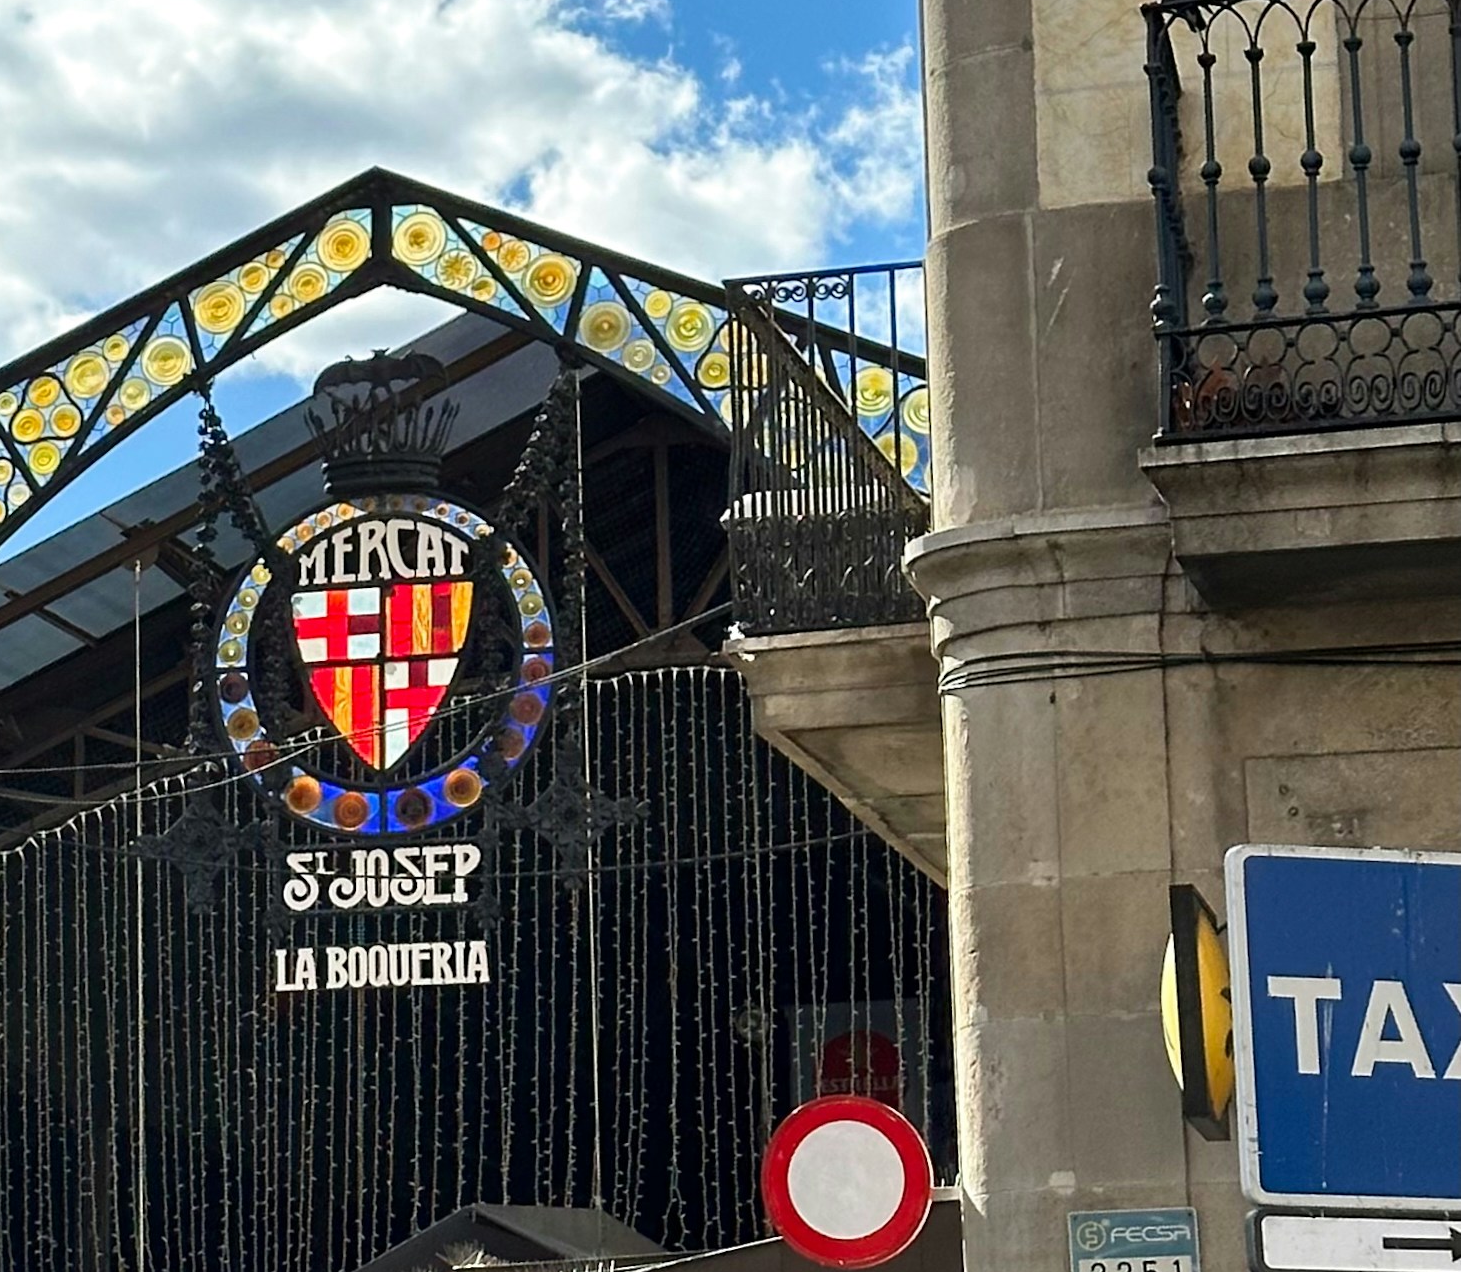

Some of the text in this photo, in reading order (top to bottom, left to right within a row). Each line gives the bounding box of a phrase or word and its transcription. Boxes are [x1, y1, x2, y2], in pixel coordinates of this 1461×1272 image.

[297, 517, 469, 587] MERCAT
[328, 843, 481, 909] JOSEP
[275, 940, 490, 992] LA BOQUERIA
[1267, 975, 1461, 1080] TA
[1110, 1224, 1191, 1243] FECSA
